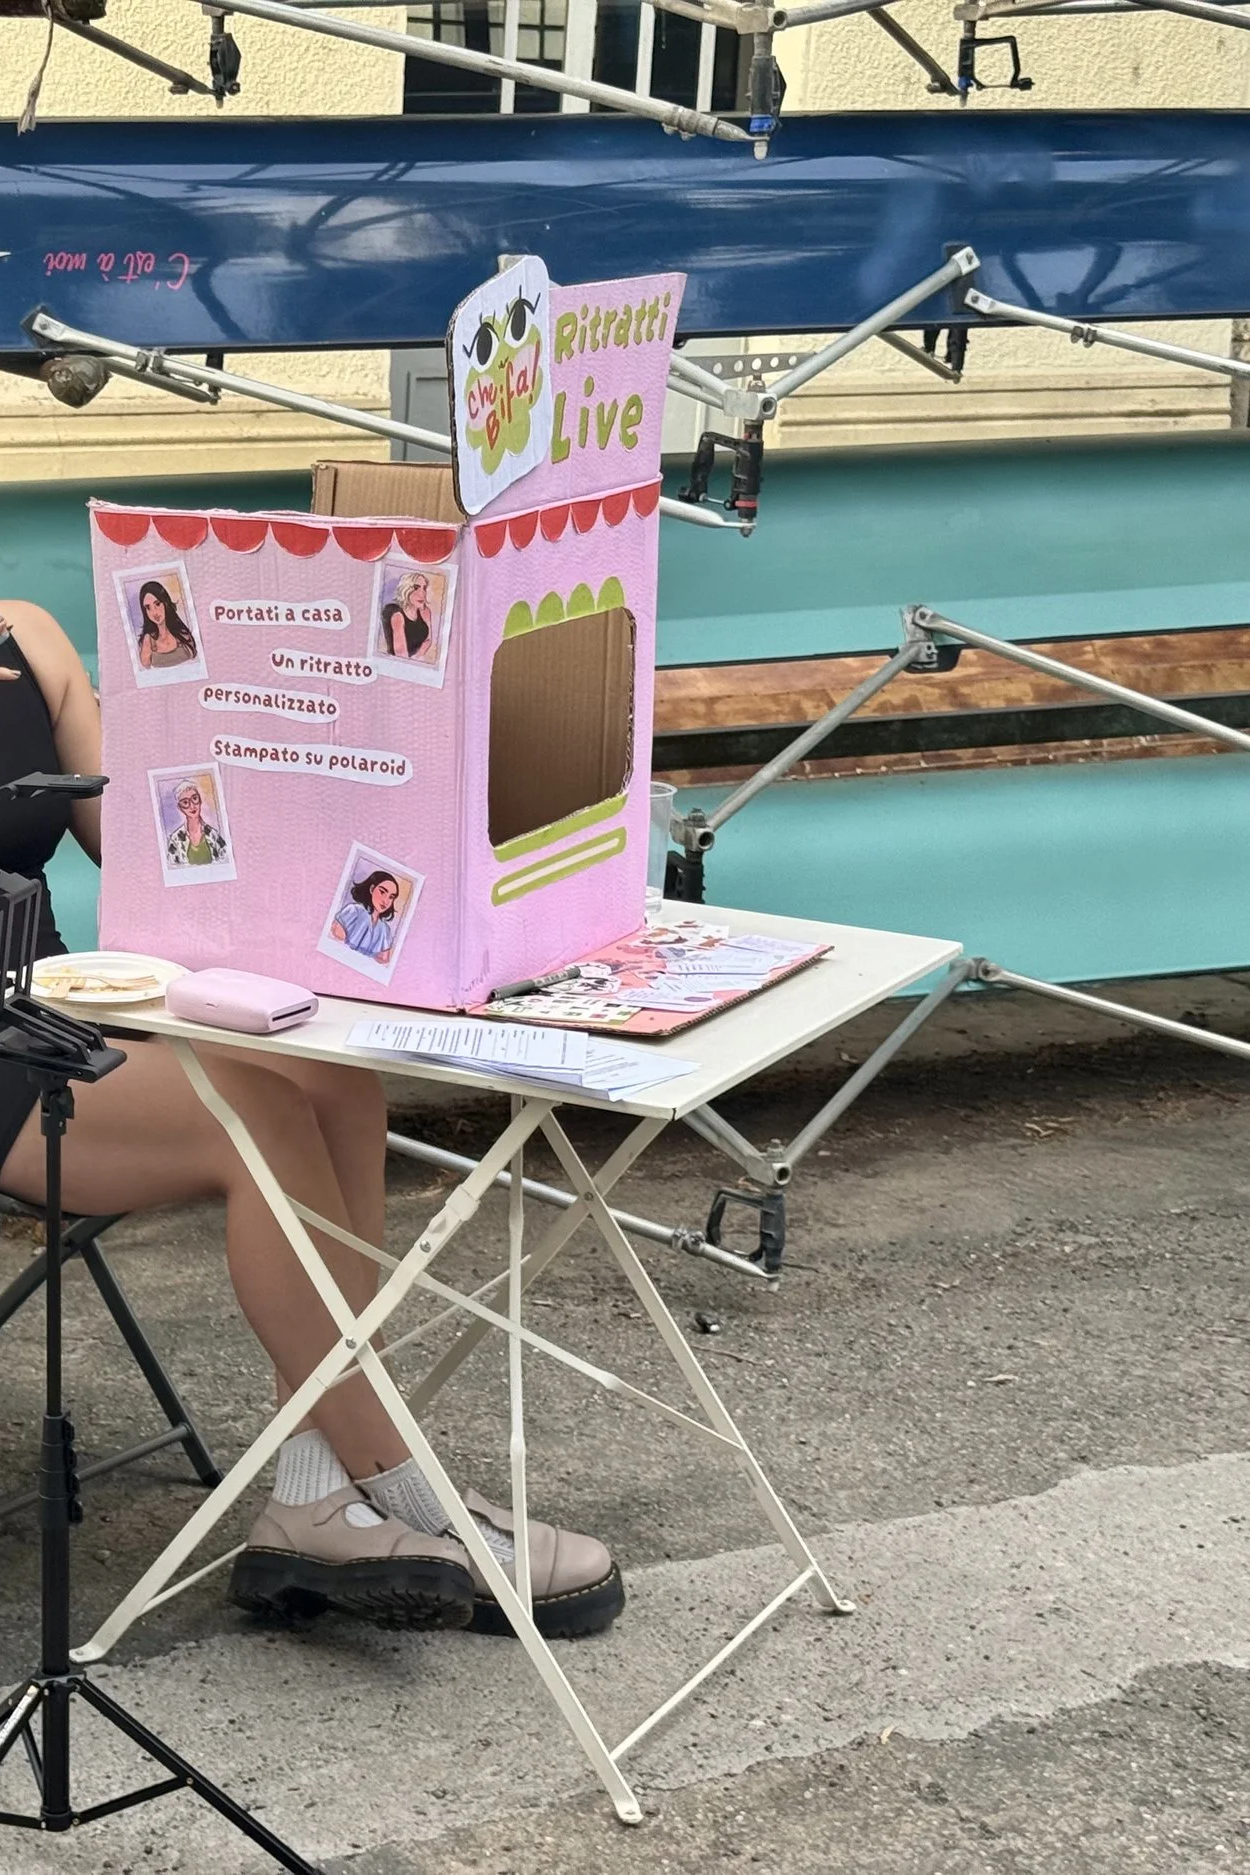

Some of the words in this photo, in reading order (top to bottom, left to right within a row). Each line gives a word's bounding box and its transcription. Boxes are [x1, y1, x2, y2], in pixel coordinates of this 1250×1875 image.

[43, 251, 87, 277] moi
[97, 252, 115, 282] à
[116, 251, 190, 291] C'est
[554, 292, 672, 364] Ritratti
[550, 376, 644, 465] Live
[214, 606, 280, 622] Portati
[286, 608, 296, 622] a
[302, 607, 344, 622] casa
[271, 654, 296, 668] Un
[300, 656, 373, 678] ritratto
[203, 686, 338, 716] personalizzato
[214, 740, 300, 763] Stampato
[305, 752, 324, 765] su
[328, 753, 406, 776] polaroid
